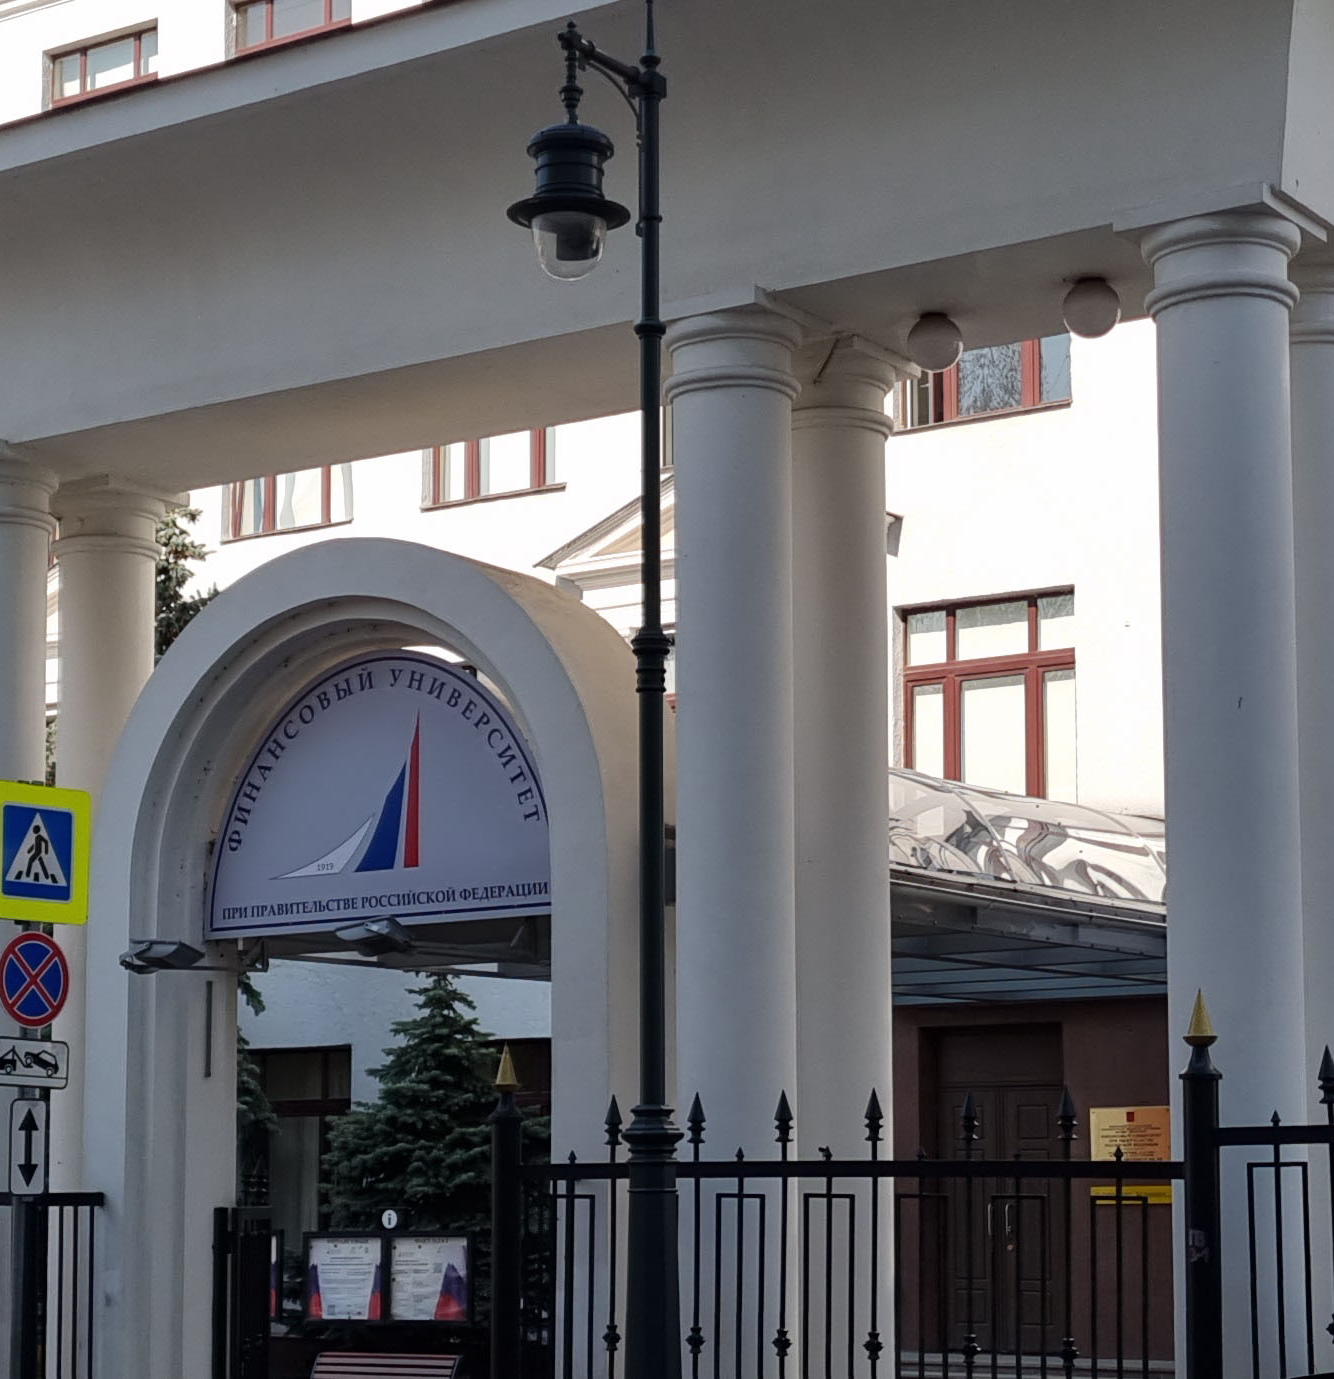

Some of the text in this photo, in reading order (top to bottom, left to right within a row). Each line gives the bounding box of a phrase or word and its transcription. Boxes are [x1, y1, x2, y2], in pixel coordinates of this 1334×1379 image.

[228, 667, 540, 853] ФИНАНСОВЫЙ УНИВЕРСИТЕТ
[222, 881, 549, 920] ПРИ ПРАВИТЕЛЬСТВЕ РОССИЙСКОЙ ФЕДЕРАЦИИ
